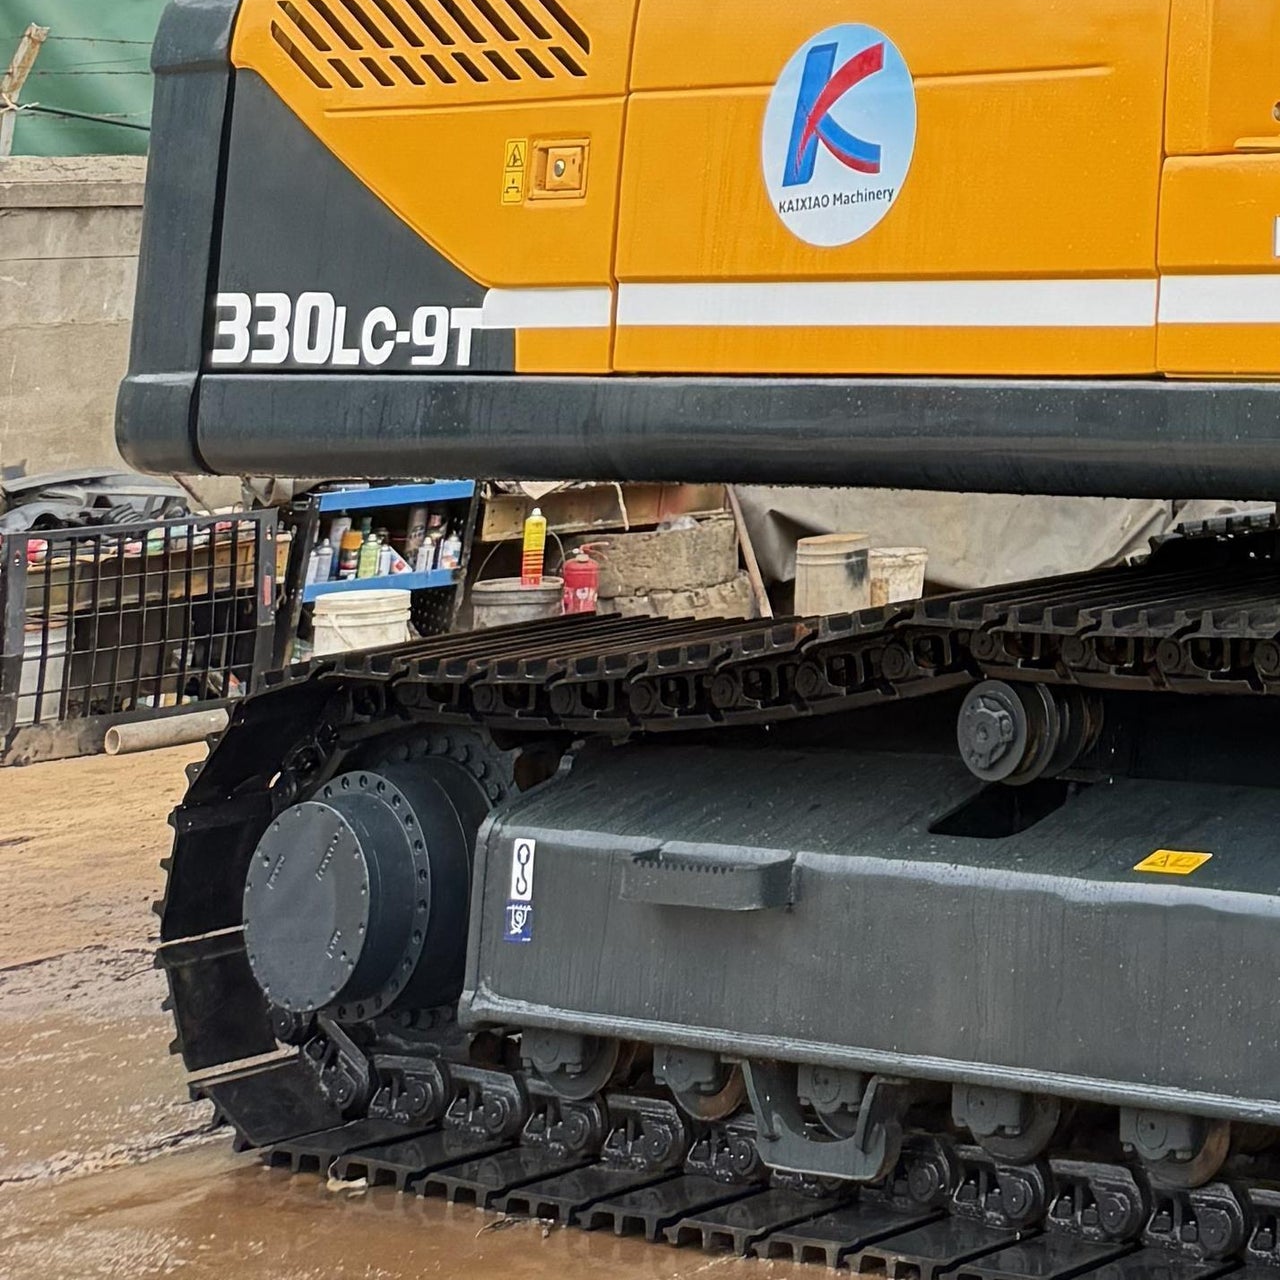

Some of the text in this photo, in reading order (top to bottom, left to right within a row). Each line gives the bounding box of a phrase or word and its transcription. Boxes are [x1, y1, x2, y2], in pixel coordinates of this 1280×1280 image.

[778, 187, 895, 214] KAIXIAO Machinery
[211, 291, 484, 366] 330LC-9T
